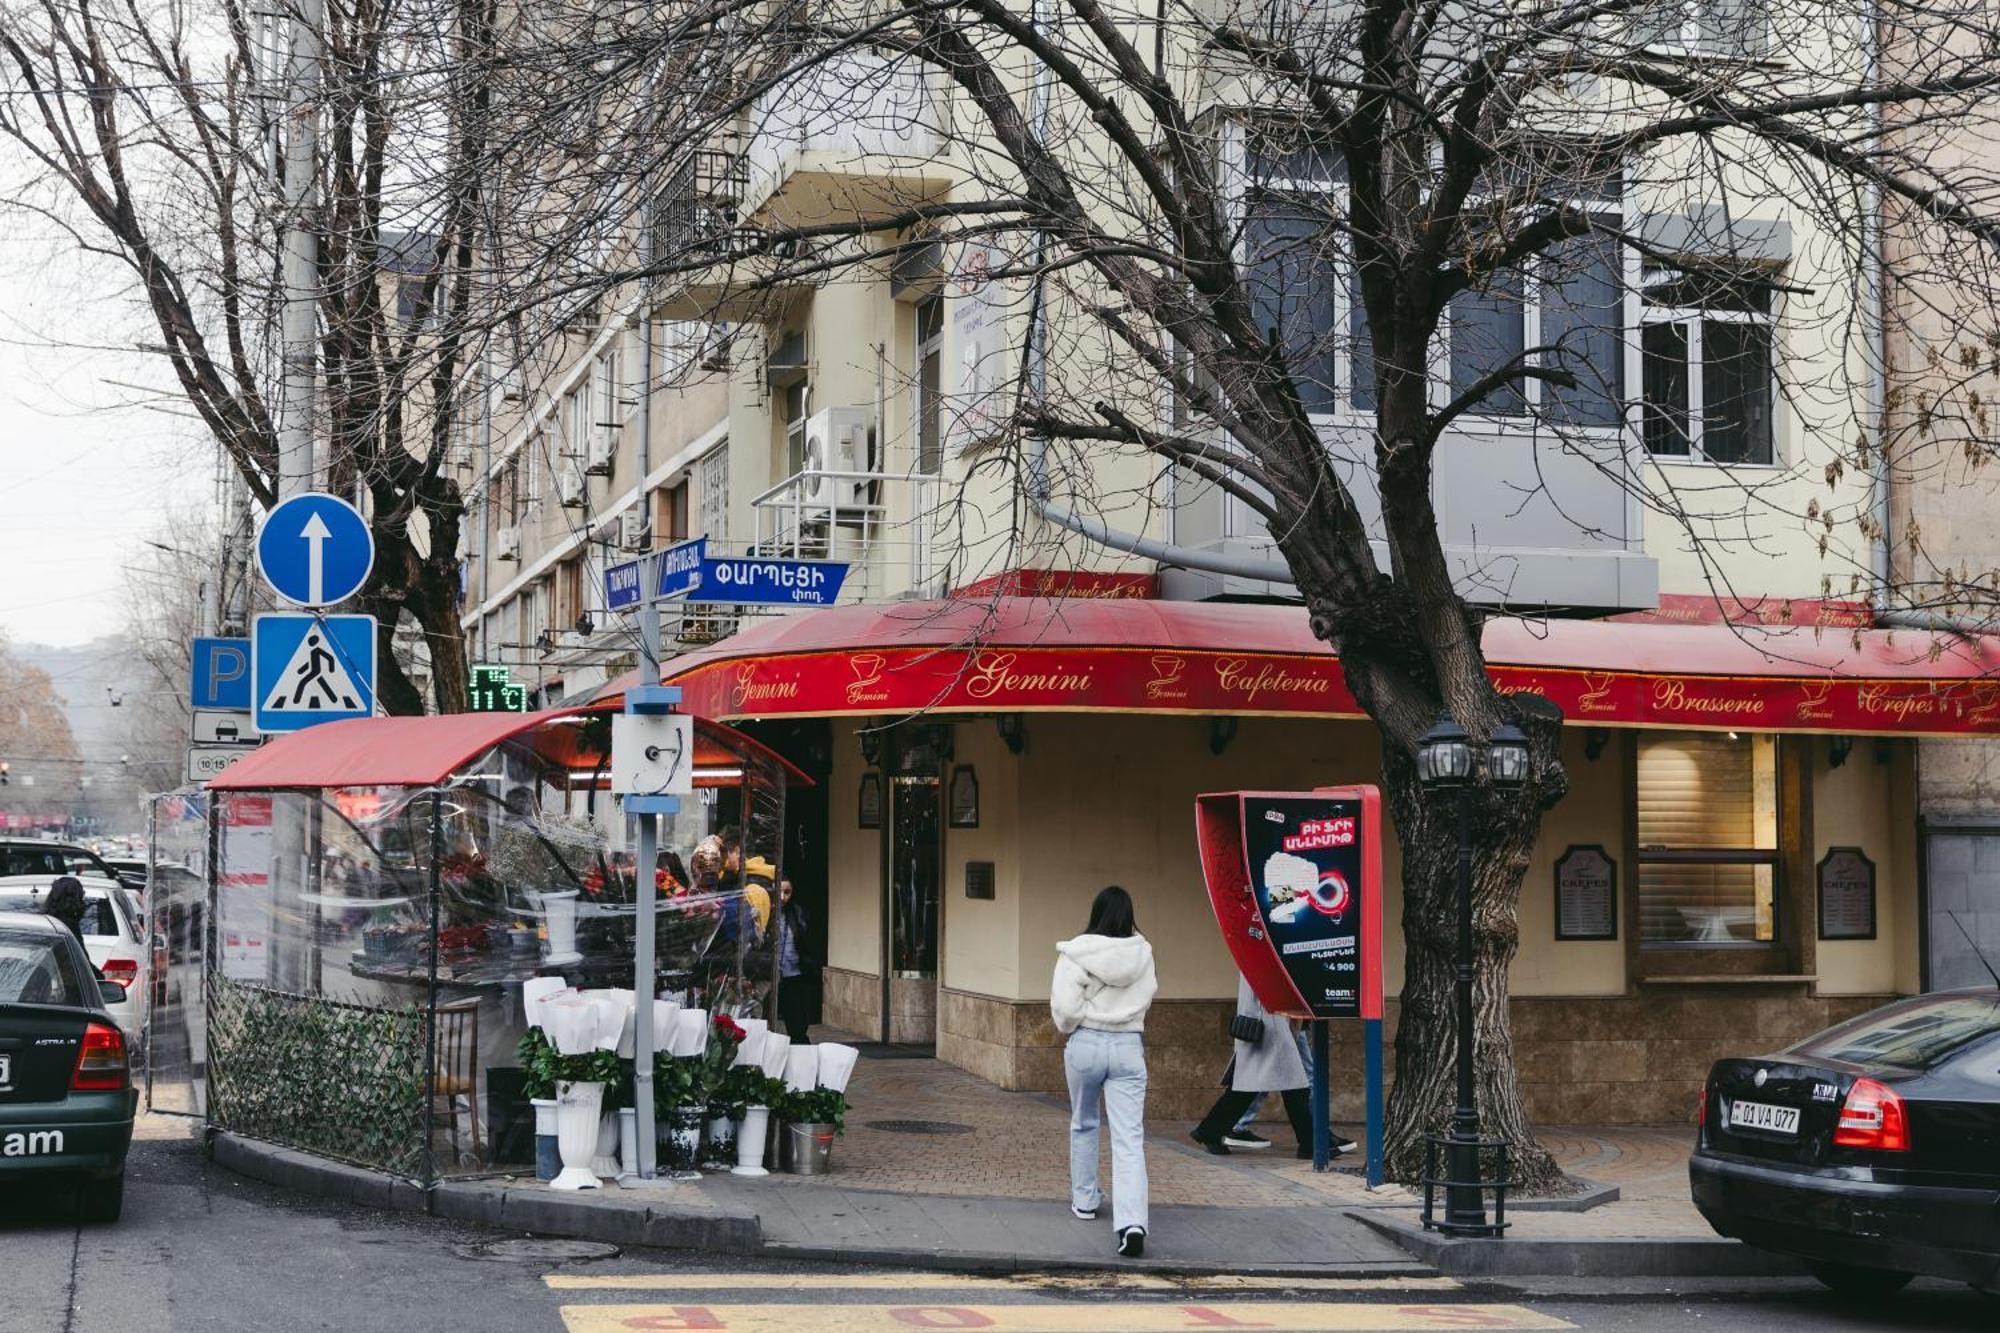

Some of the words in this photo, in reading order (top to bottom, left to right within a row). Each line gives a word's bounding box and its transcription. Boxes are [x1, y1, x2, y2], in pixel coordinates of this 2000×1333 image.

[715, 563, 825, 588] ՓԱՐՊԵՑԻ
[792, 587, 824, 603] փող.
[208, 647, 247, 702] P
[732, 664, 801, 707] Gemini
[966, 651, 1095, 698] Gemini
[1214, 656, 1330, 703] Cafeteria
[1652, 677, 1766, 714] Brasserie
[201, 761, 211, 770] 10
[214, 760, 225, 770] 15
[1325, 987, 1350, 997] team
[1743, 1104, 1756, 1124] 01
[1758, 1106, 1771, 1127] VA
[1774, 1108, 1797, 1130] 077
